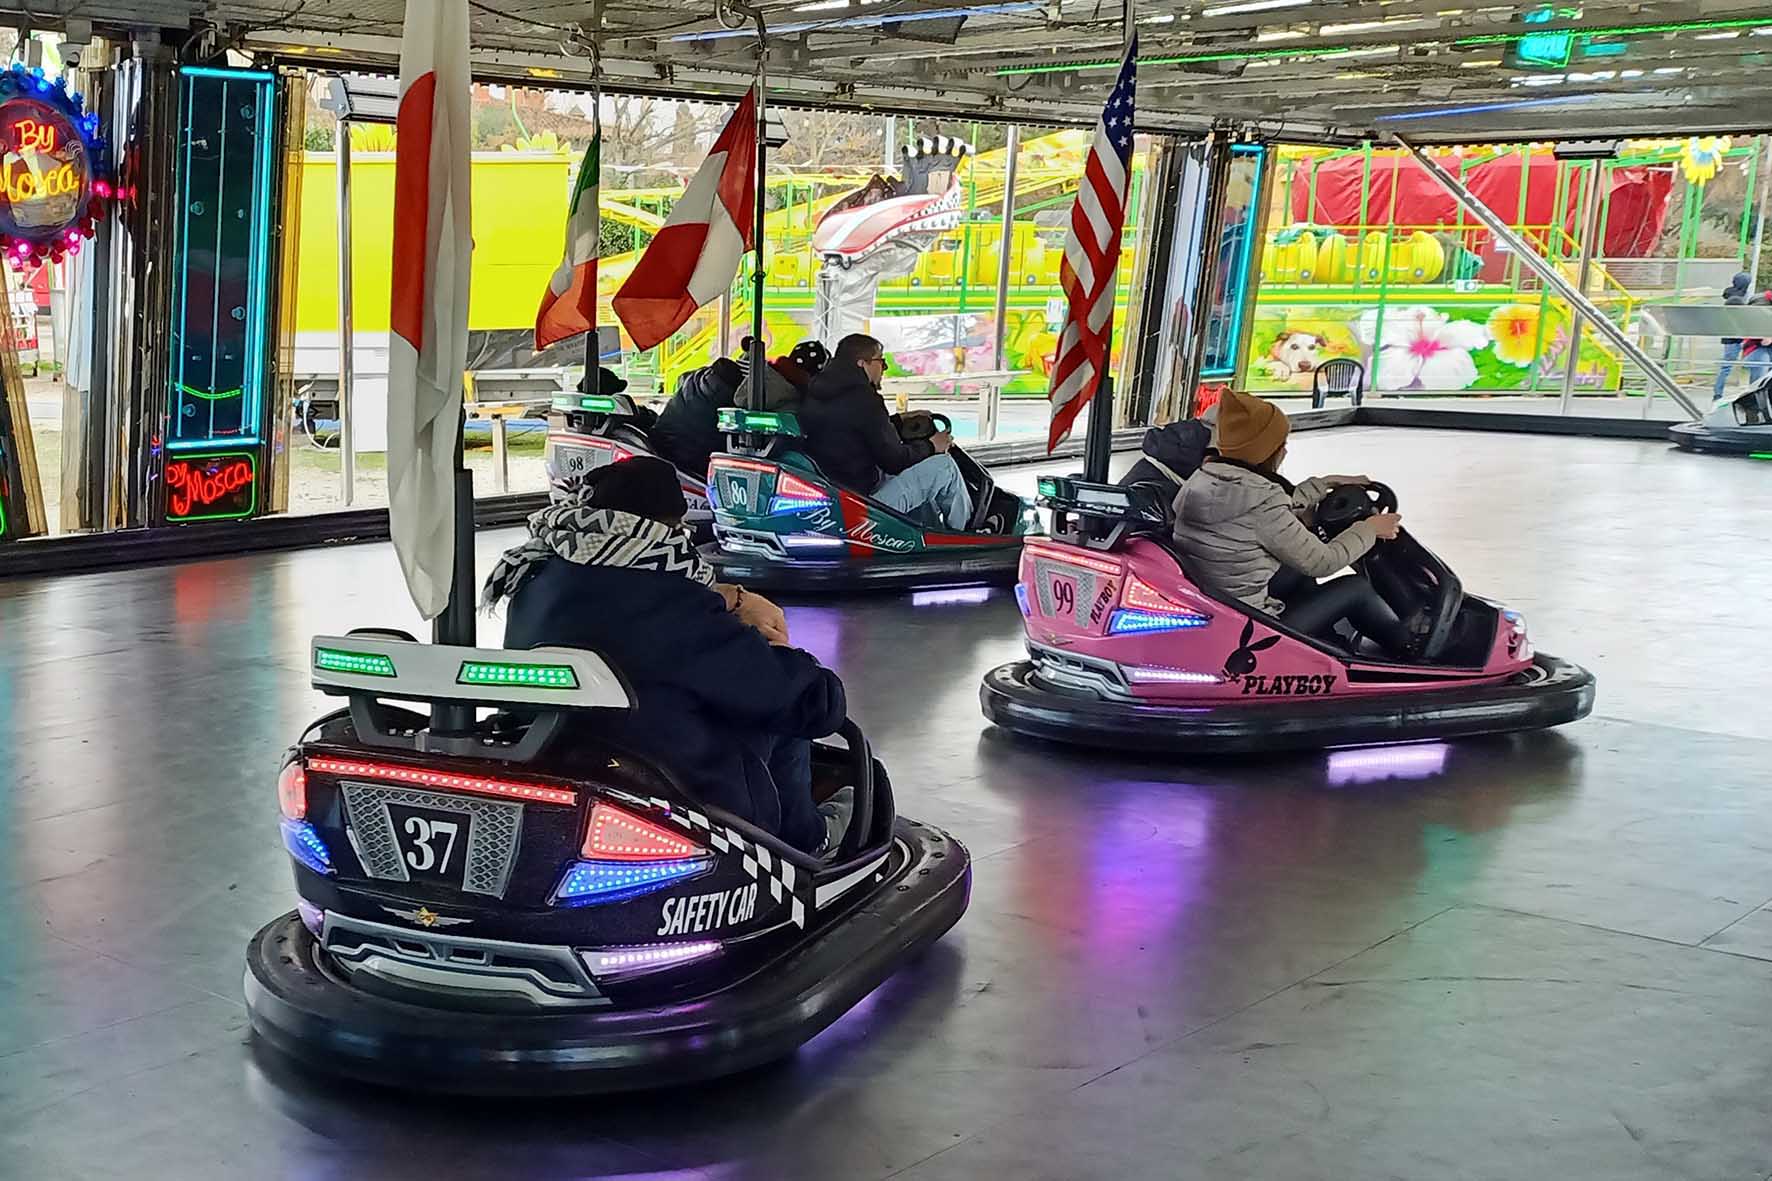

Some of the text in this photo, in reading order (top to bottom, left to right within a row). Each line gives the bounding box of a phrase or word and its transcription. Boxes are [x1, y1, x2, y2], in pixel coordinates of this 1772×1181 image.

[14, 118, 56, 154] By
[569, 456, 585, 473] 98
[172, 462, 253, 516] Mosca
[730, 479, 748, 506] 80
[796, 506, 917, 553] By Mosca
[1053, 579, 1075, 615] 99
[1089, 579, 1118, 626] PLAYBOY
[1241, 675, 1337, 695] PLAYBOY
[404, 815, 459, 875] 37
[656, 881, 759, 937] SAFETY CAR
